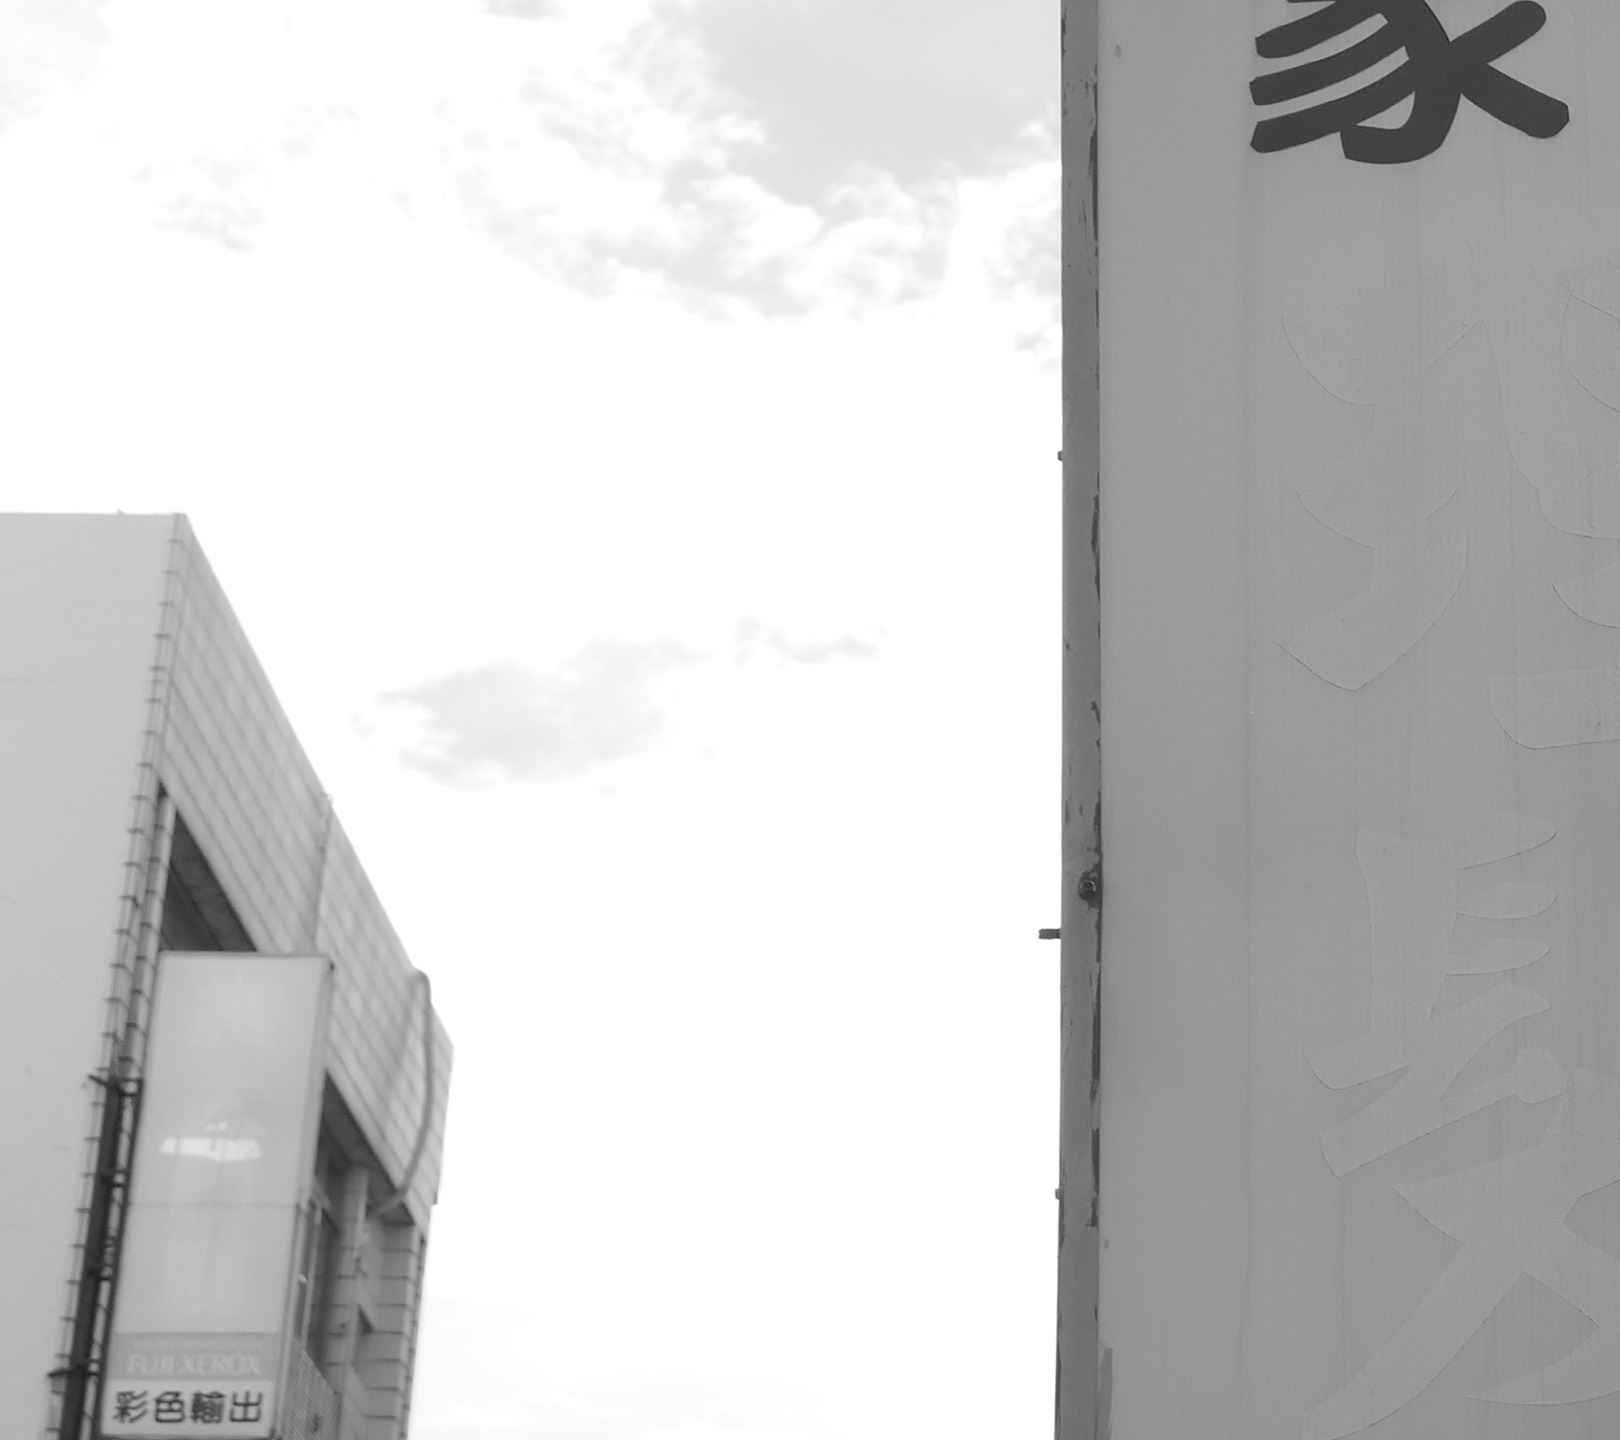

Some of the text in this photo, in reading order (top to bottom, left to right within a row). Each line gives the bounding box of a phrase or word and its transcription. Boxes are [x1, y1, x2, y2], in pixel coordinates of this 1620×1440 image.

[126, 1352, 262, 1376] FUJI XEROX
[112, 1389, 264, 1424] 彩色輸出
